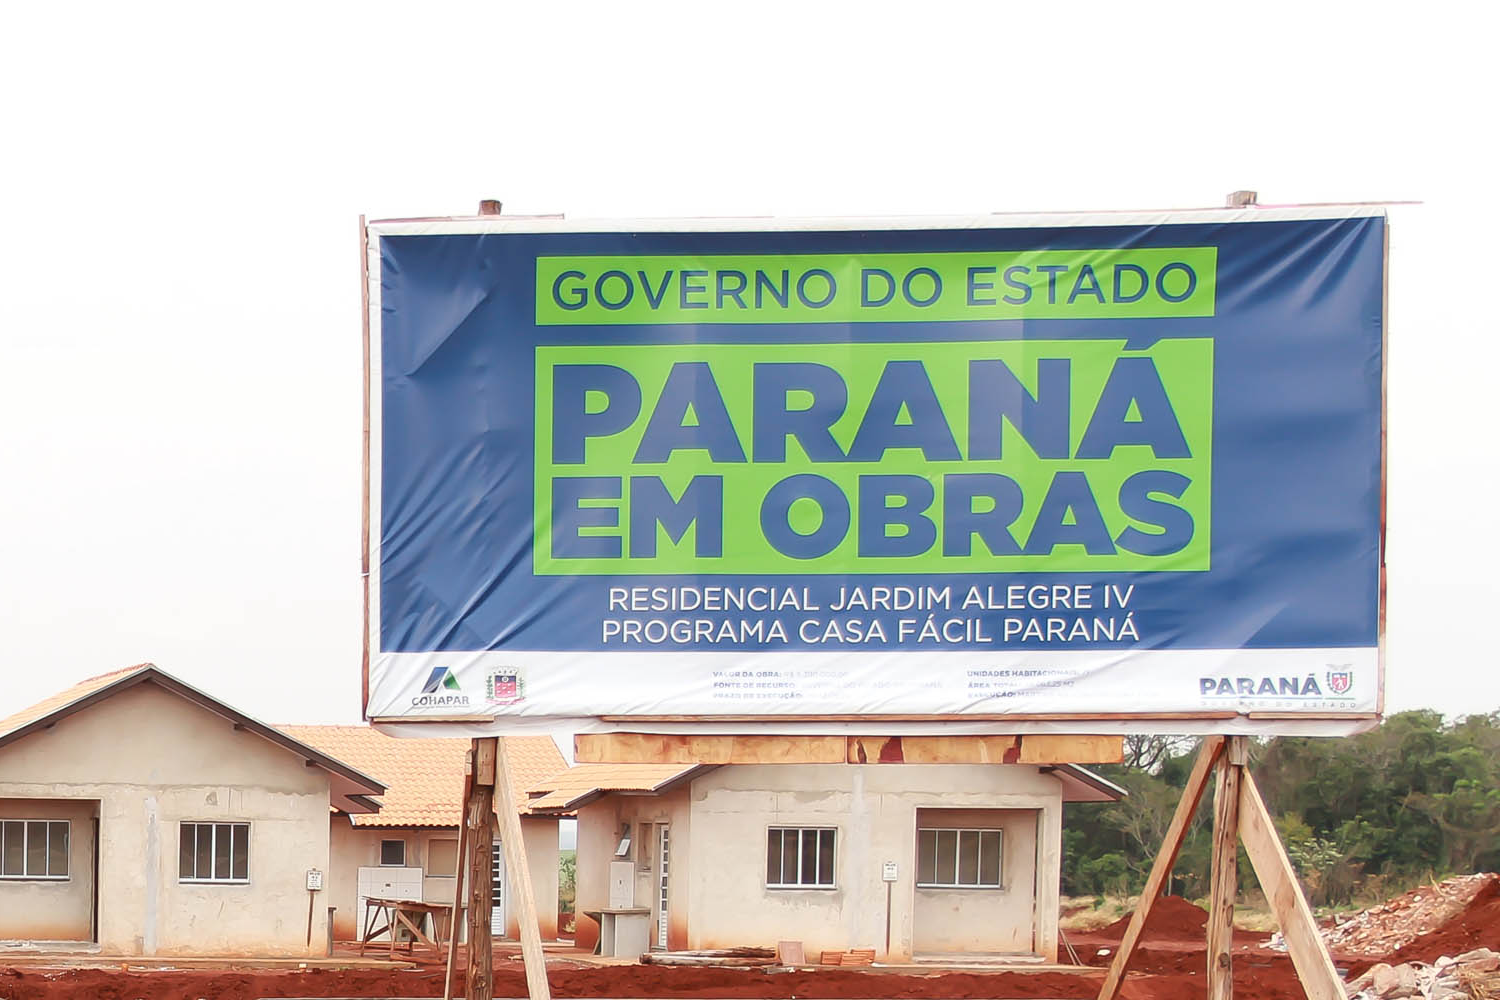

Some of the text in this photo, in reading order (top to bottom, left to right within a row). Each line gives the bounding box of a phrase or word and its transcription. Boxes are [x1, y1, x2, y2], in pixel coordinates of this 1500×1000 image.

[552, 262, 1197, 311] GOVERNO DO ESTADO
[551, 338, 1193, 465] PARANÁ
[550, 470, 1195, 560] EM OBRAS
[609, 584, 1134, 611] RESIDENCIAL JARDIM ALEGRE IV
[602, 611, 1140, 643] PROGRAMA CASA FÁCIL PARANÁ
[411, 695, 470, 706] COHAPAR
[1199, 673, 1322, 696] PARANÁ
